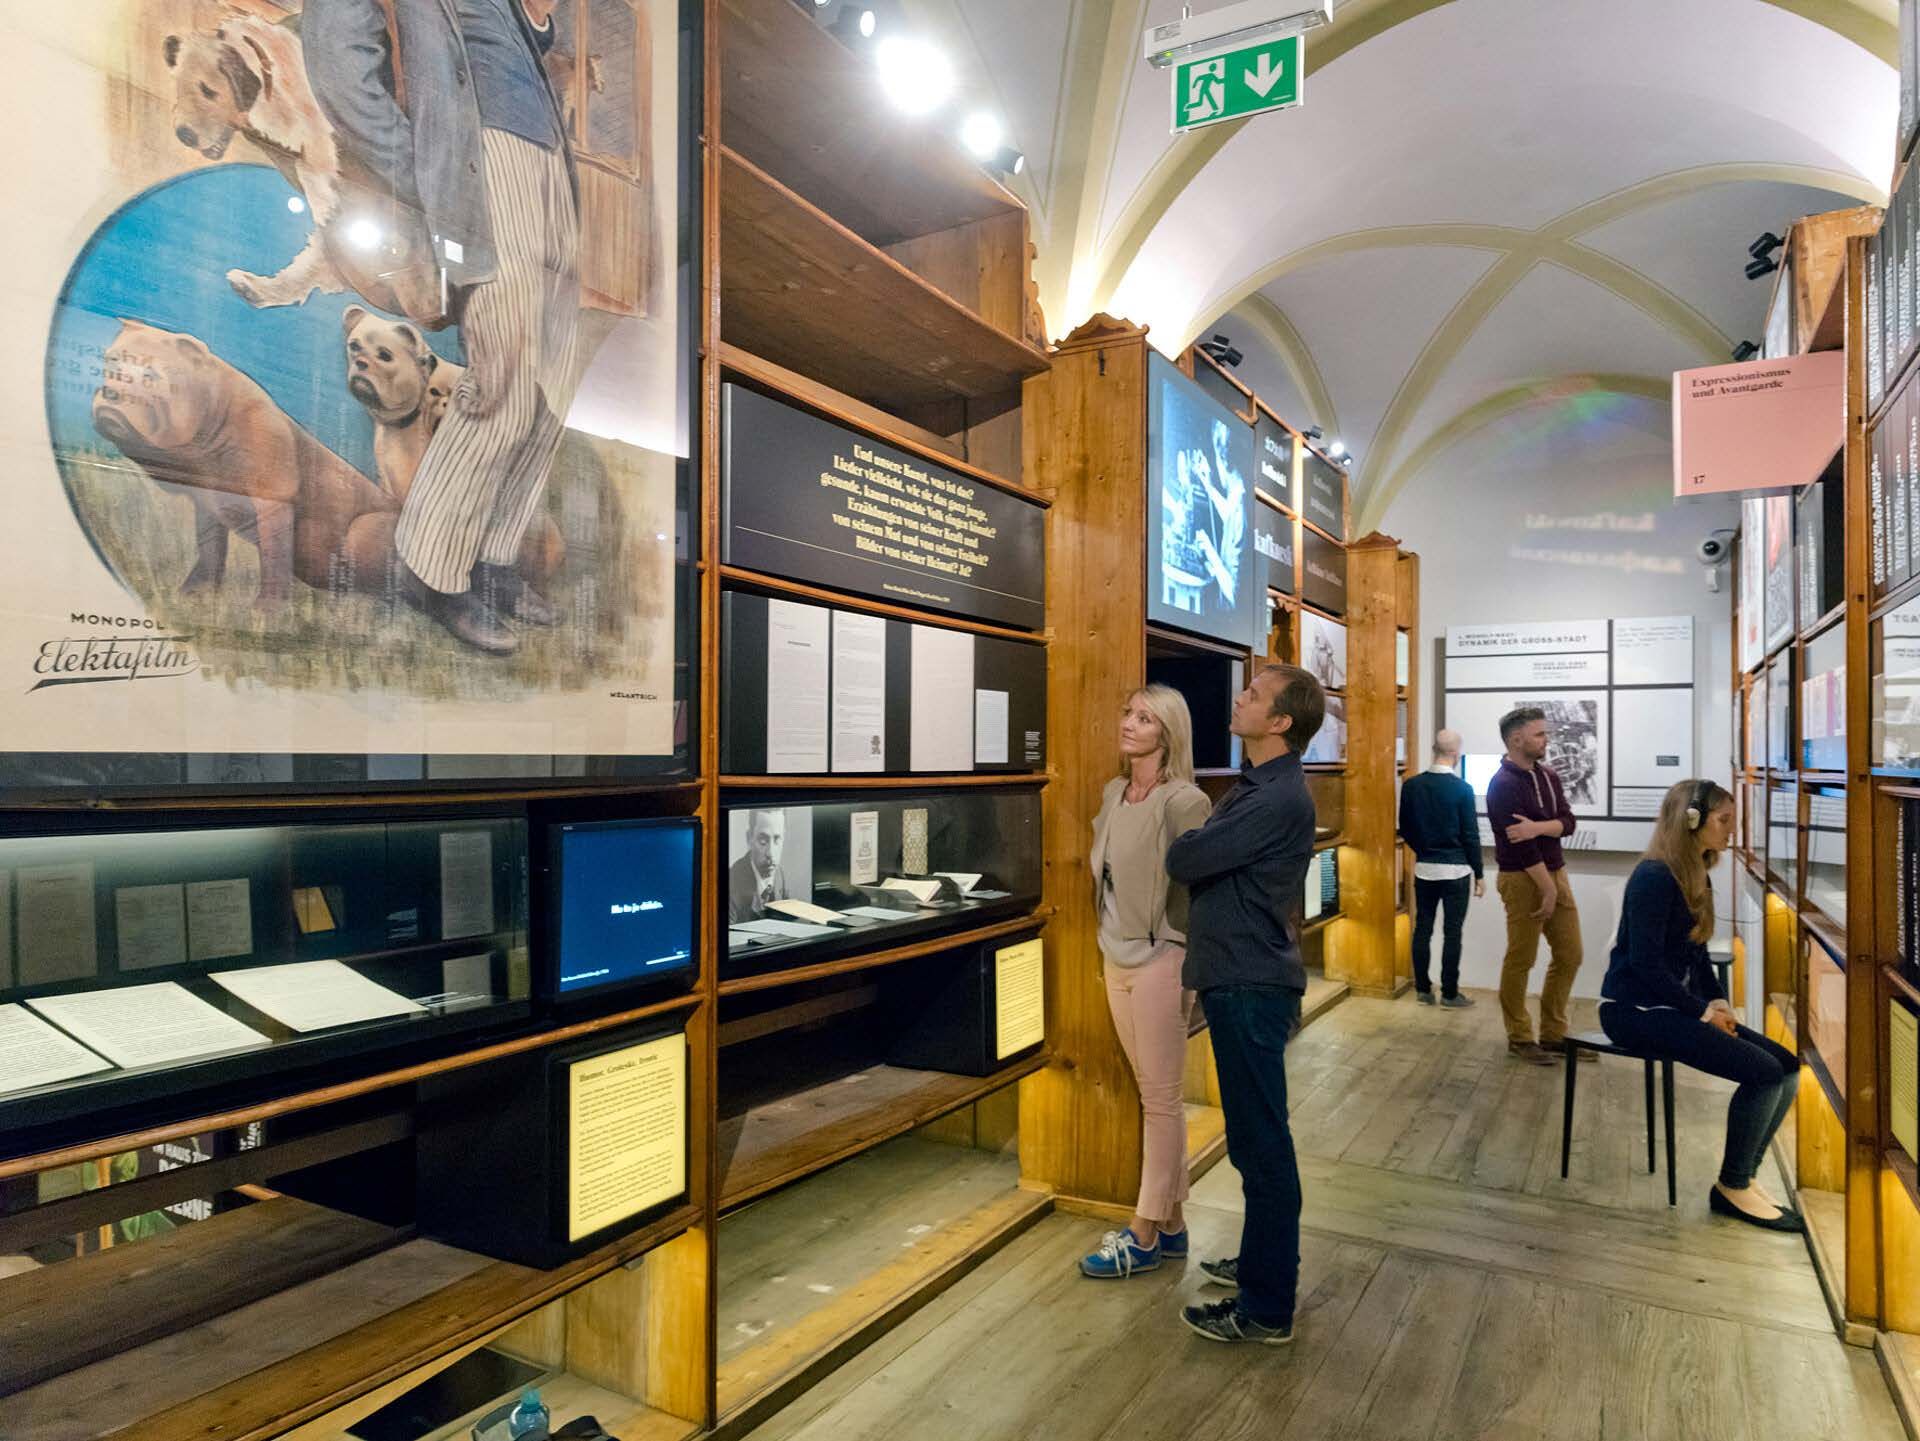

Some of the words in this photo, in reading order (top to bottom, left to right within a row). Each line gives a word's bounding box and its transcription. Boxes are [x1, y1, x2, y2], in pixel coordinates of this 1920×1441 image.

[1691, 368, 1792, 389] Expressionismus
[1691, 389, 1715, 399] und
[1719, 380, 1784, 396] Avantgarde
[833, 455, 863, 477] Lieder
[1693, 475, 1705, 485] 17
[71, 613, 165, 630] MONOPOL
[1458, 639, 1498, 647] DYNAMIK
[31, 635, 200, 686] Elektafilm
